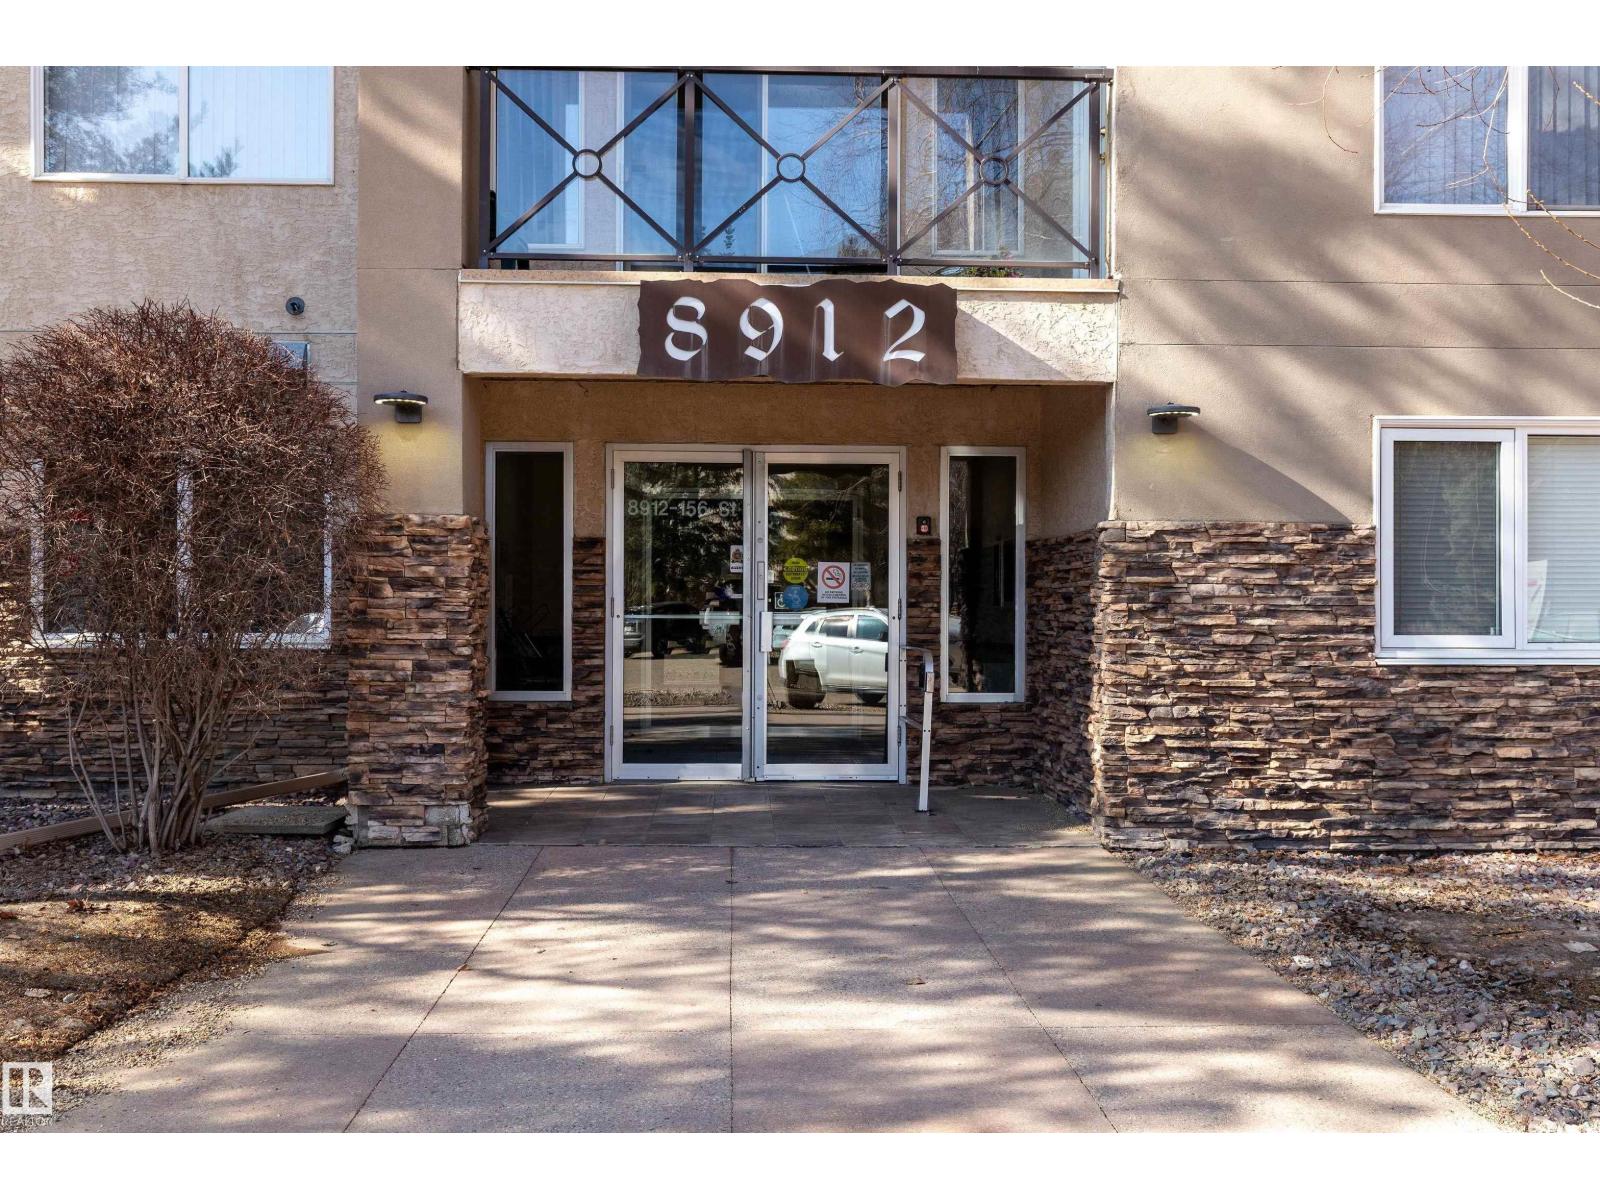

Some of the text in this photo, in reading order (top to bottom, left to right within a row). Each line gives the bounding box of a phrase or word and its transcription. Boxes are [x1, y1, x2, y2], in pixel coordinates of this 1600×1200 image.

[664, 296, 927, 362] 8912
[627, 499, 738, 518] 8912-156 St
